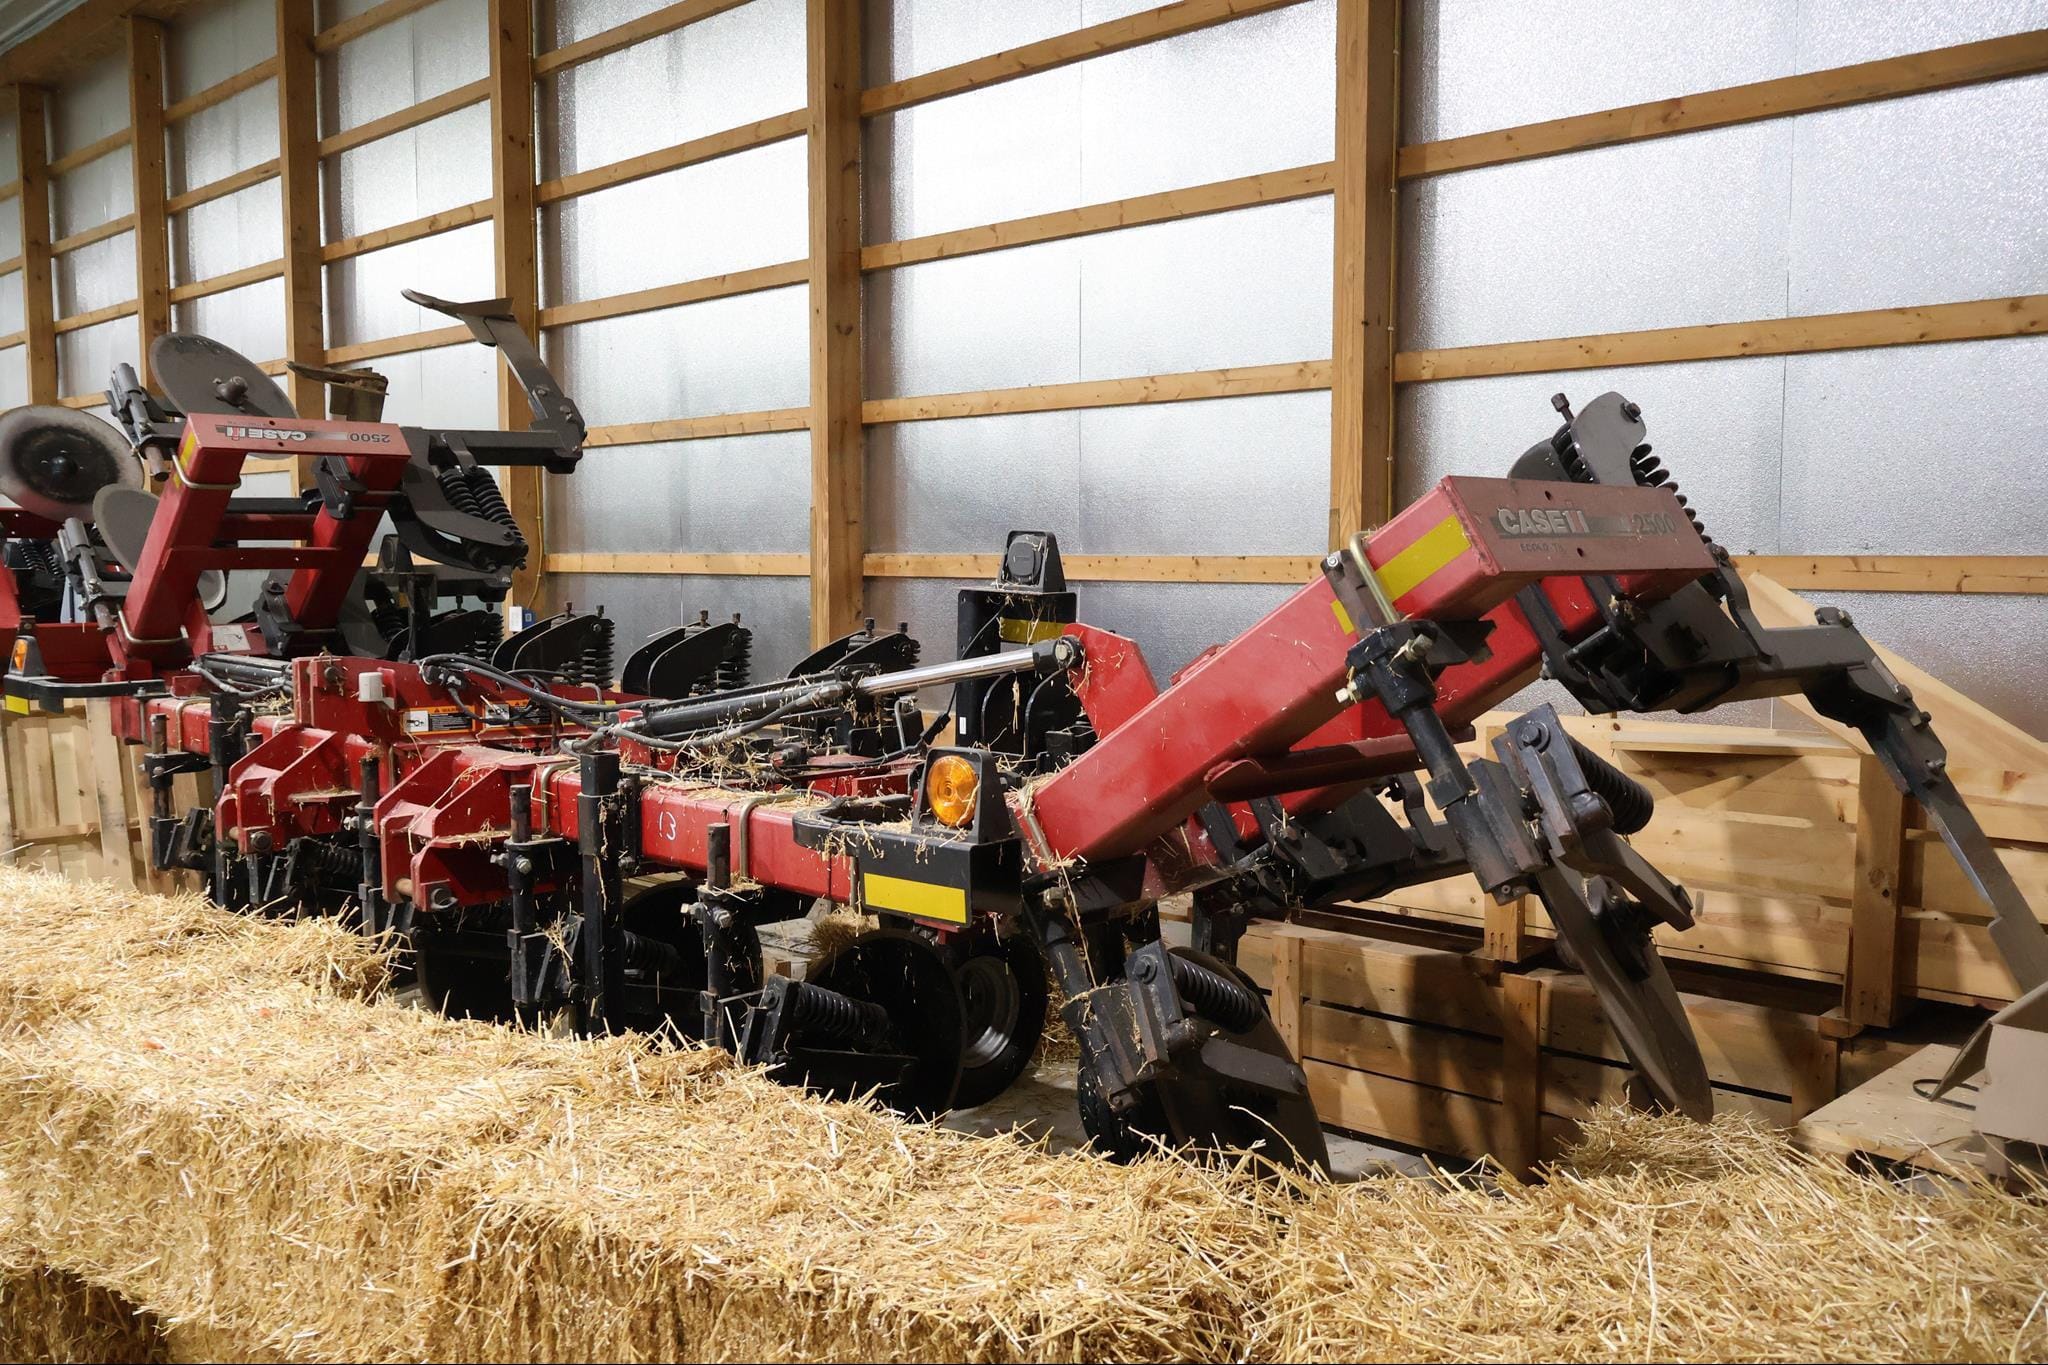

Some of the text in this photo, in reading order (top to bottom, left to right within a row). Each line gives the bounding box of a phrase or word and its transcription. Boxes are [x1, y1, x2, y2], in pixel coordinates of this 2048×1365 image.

[350, 432, 391, 443] 2500
[1632, 511, 1676, 535] 2500
[659, 811, 676, 840] 13
